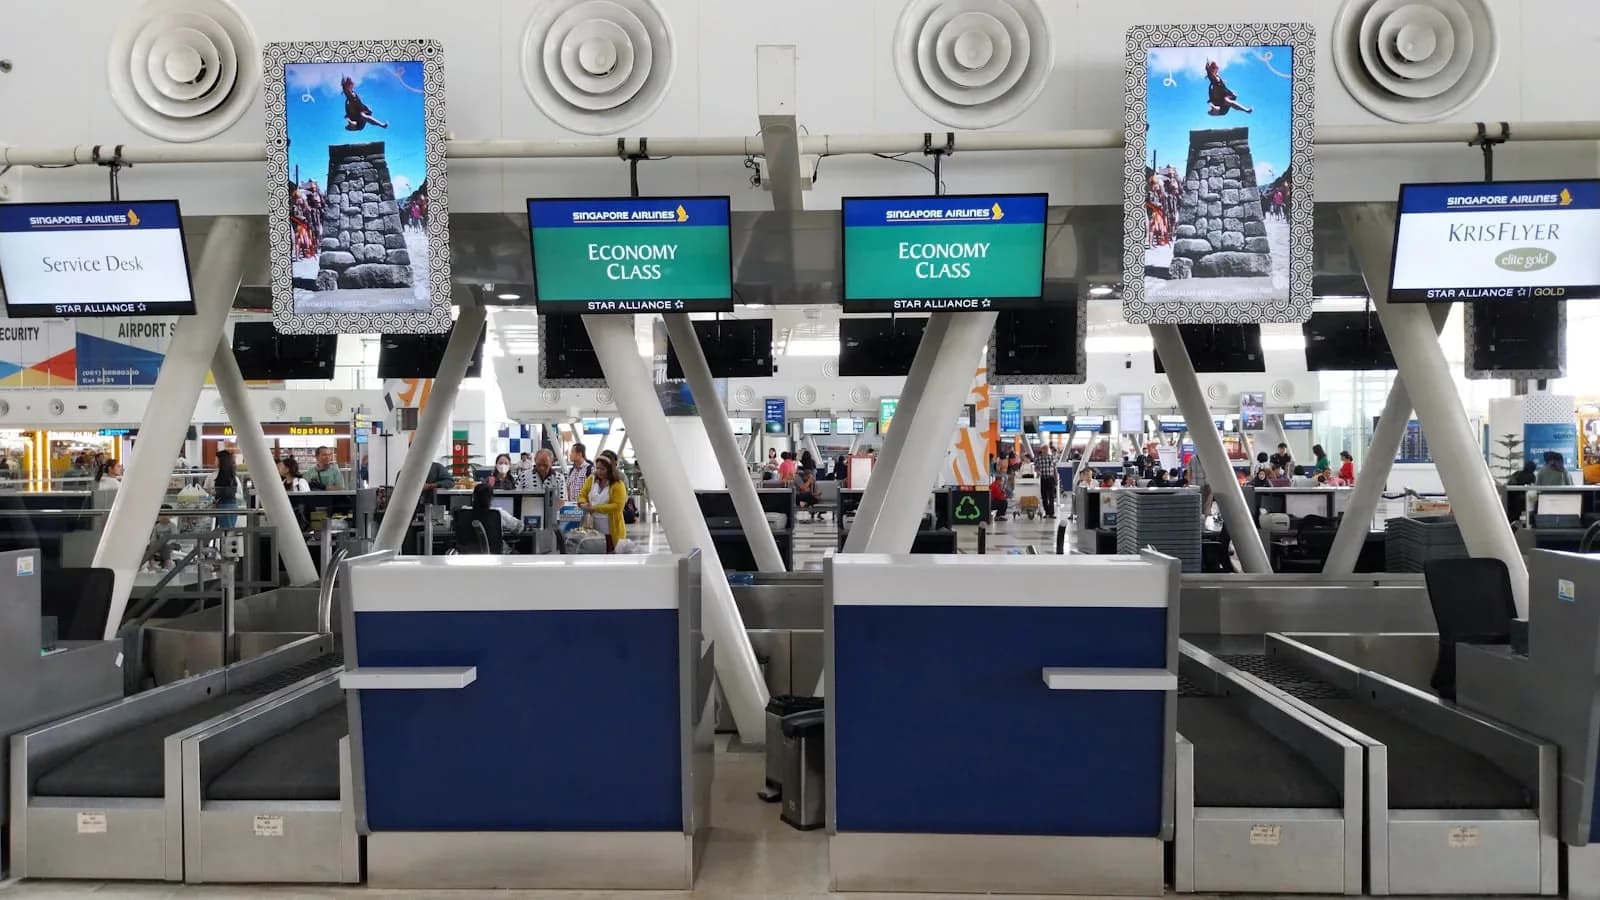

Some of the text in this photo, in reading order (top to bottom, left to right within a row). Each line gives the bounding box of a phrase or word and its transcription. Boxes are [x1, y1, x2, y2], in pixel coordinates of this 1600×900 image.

[1447, 194, 1558, 205] SINGAPORE AIRLINES
[29, 215, 127, 225] SINGAPORE AIRLINES
[572, 211, 675, 220] SINGAPORE AIRLINES
[886, 209, 990, 219] SINGAPORE AIRLINES
[1449, 222, 1560, 242] KRISFLYER
[588, 243, 678, 260] ECONOMY
[898, 242, 991, 259] ECONOMY
[42, 255, 144, 273] Service Desk
[1502, 252, 1549, 269] elite gold
[607, 263, 662, 280] CLASS
[915, 261, 971, 279] CLASS
[1427, 287, 1565, 298] STAR ALLIANCE GOLD
[56, 303, 135, 313] STAR ALLIANCE
[588, 300, 672, 310] STAR ALLIANCE
[893, 299, 978, 308] STAR ALLIANCE
[0, 327, 40, 341] ECURITY
[118, 322, 166, 338] AIRPORT
